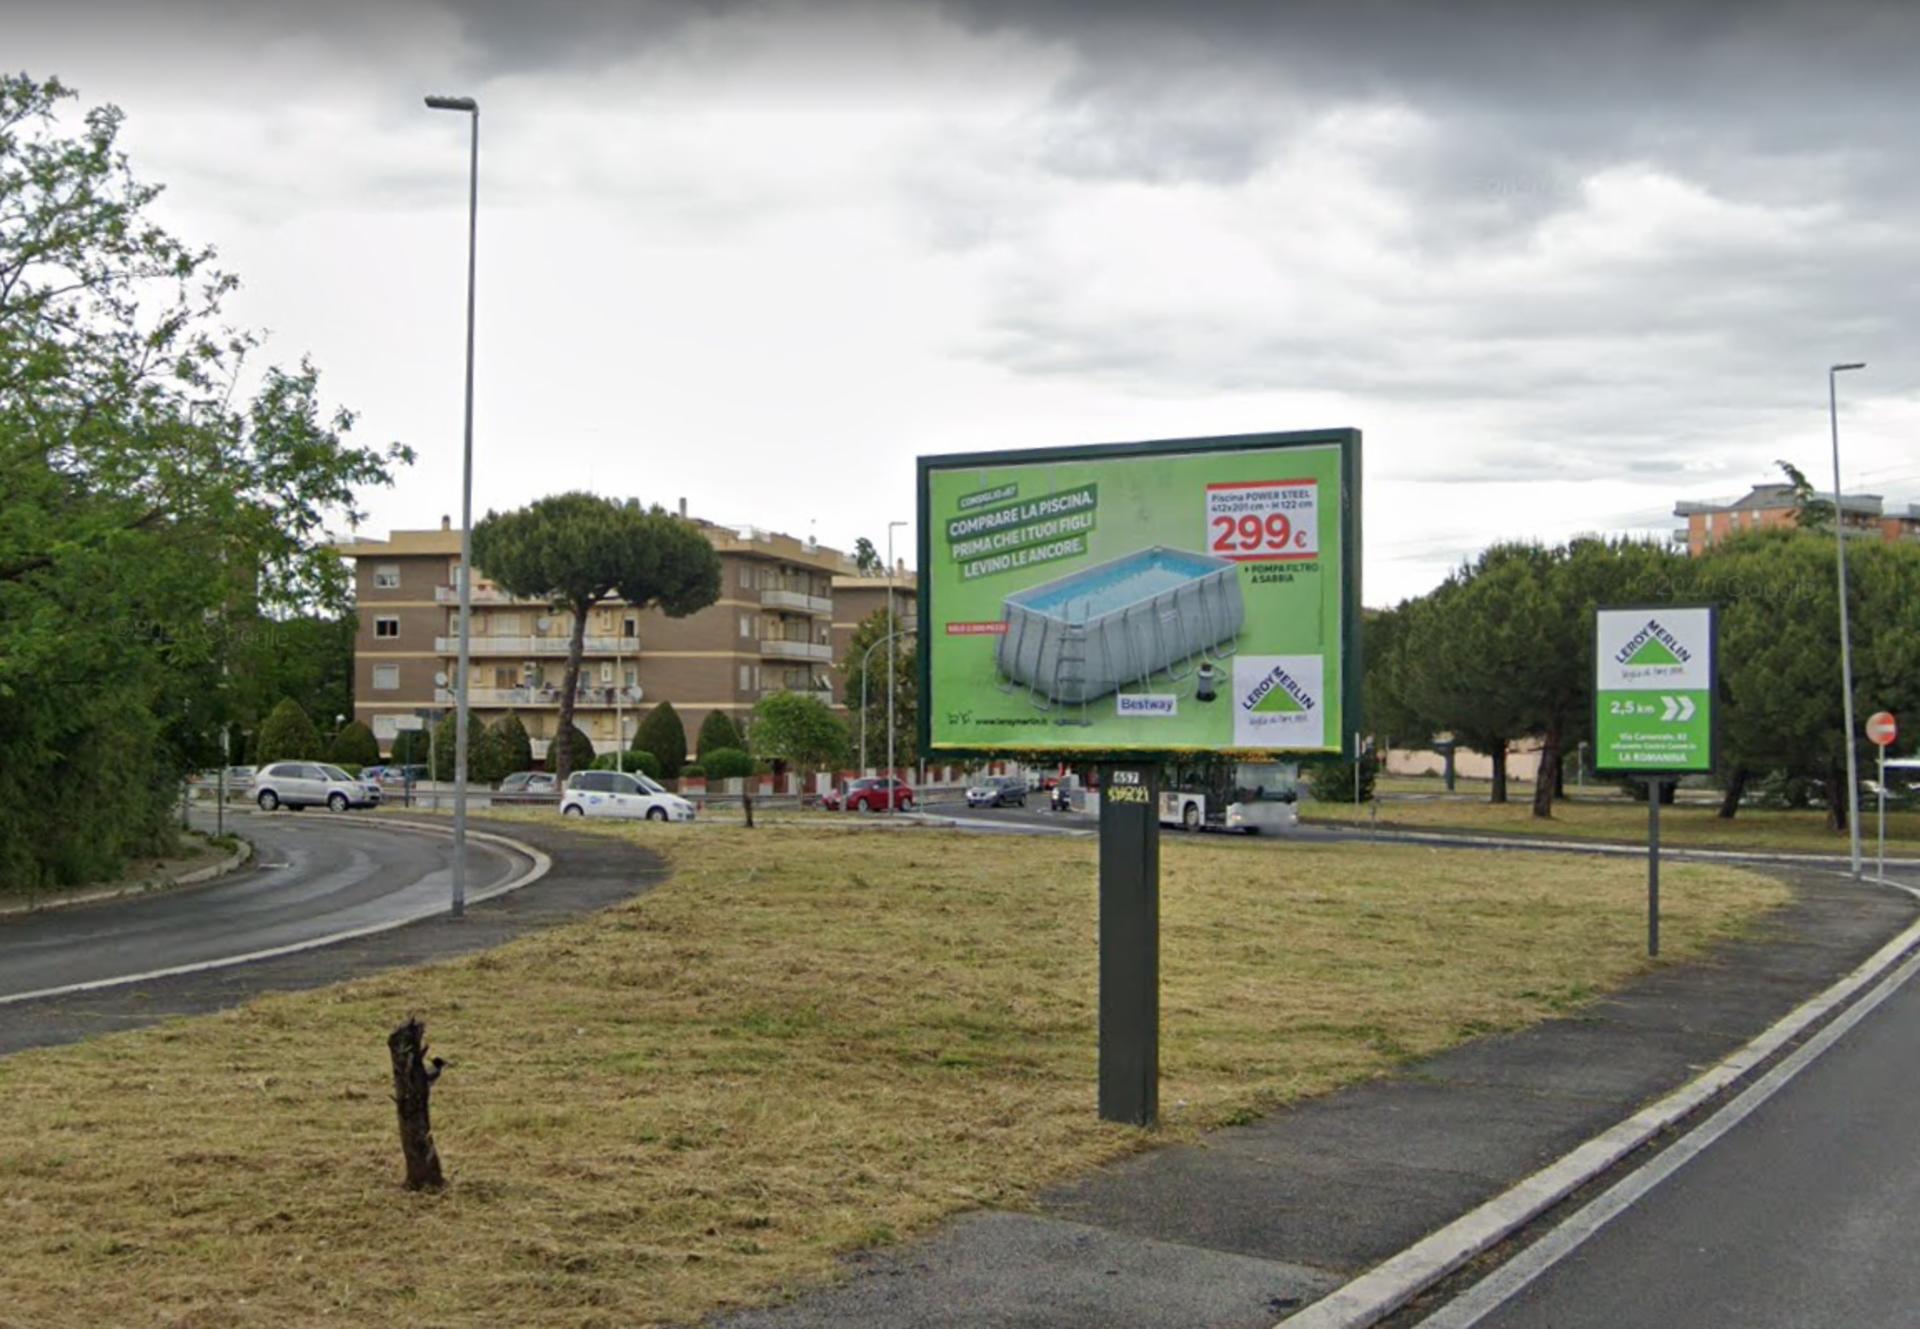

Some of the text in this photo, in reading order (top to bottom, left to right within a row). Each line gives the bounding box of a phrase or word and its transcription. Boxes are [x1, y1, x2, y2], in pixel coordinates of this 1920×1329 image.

[1211, 490, 1310, 502] Piscina POWER STEEL
[1211, 502, 1249, 512] 412x201
[1272, 501, 1279, 509] H
[1281, 500, 1296, 509] 122
[1298, 500, 1313, 508] cm
[950, 508, 1018, 536] COMPRARE
[1021, 503, 1037, 520] LA
[952, 513, 1092, 559] PRIMA CHE I TUOI FIGLI
[1212, 513, 1307, 551] 299 €
[964, 538, 1084, 577] LEVINO LE ANCORE.
[1251, 564, 1285, 573] POMPA
[1287, 563, 1319, 572] FILTRO
[1251, 574, 1294, 584] A SABBIA
[1615, 619, 1691, 663] LEROY MERLIN
[1242, 665, 1315, 710] LEROY MERLIN
[1121, 699, 1174, 712] Bestway
[1611, 700, 1655, 715] 2,5 km
